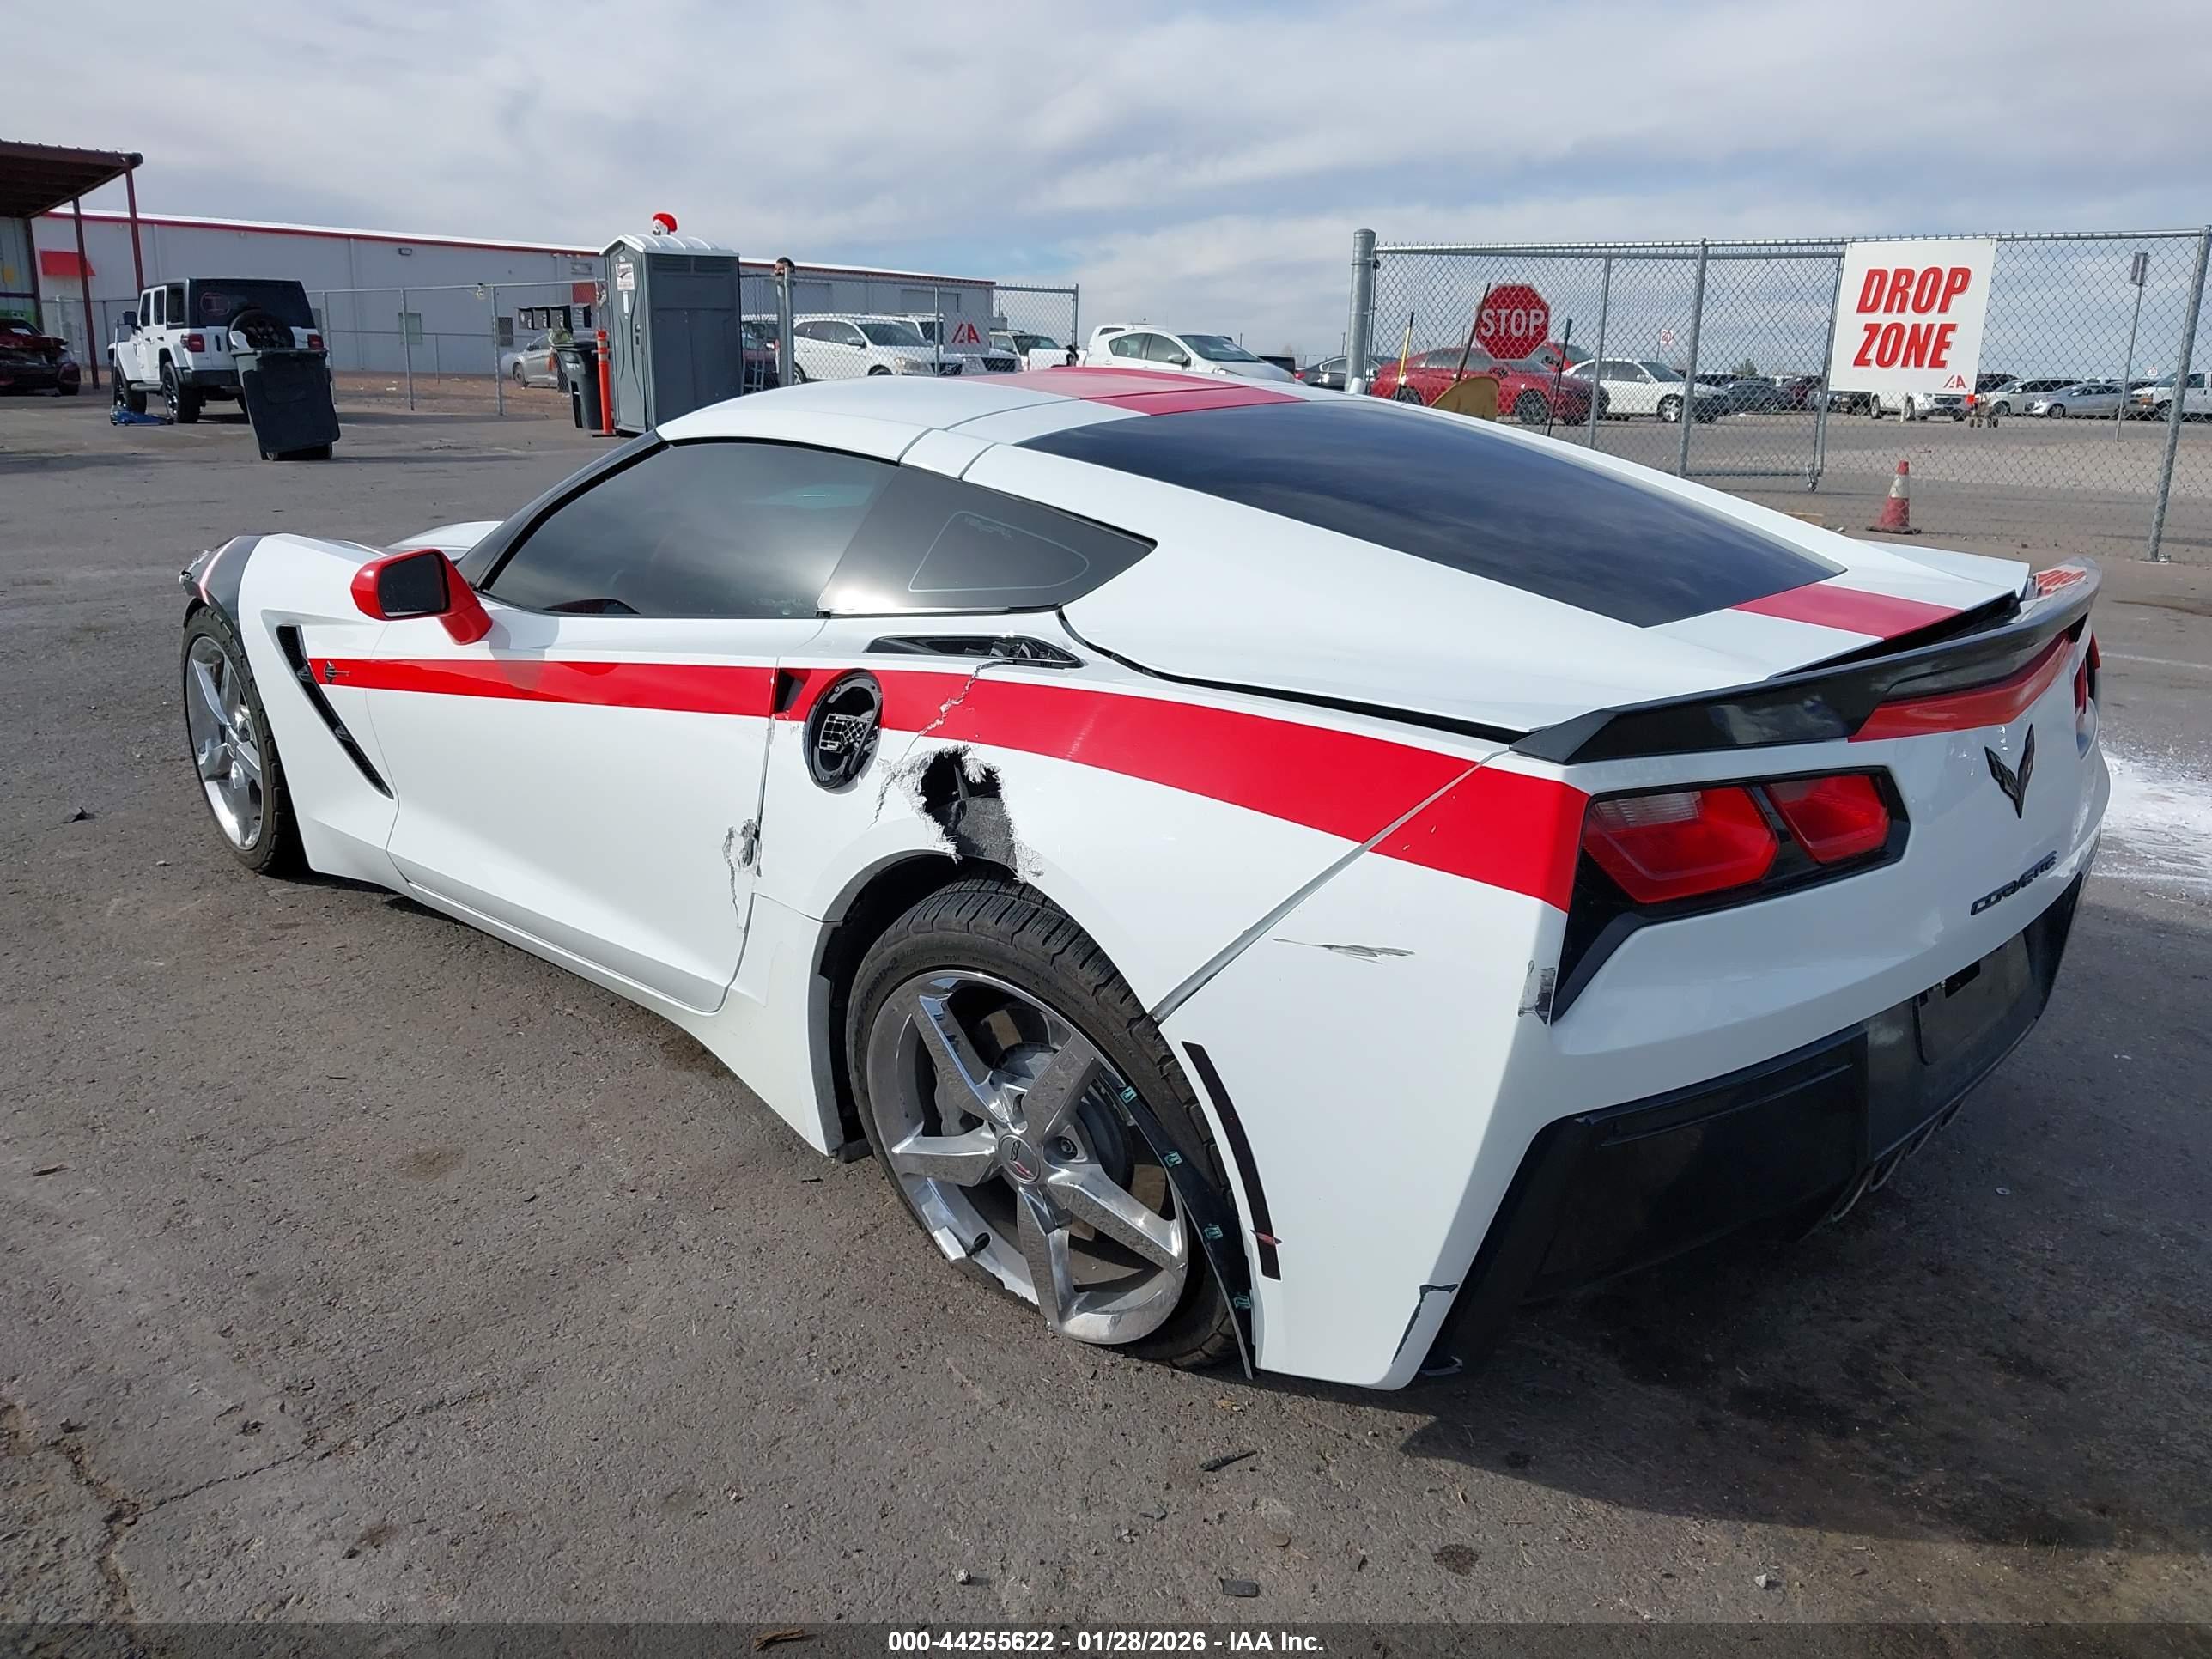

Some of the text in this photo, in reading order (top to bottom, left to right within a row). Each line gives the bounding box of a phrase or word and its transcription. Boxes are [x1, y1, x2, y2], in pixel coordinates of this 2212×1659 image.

[1856, 266, 1972, 314] DROP
[1480, 308, 1546, 337] STOP
[1852, 322, 1959, 369] ZONE
